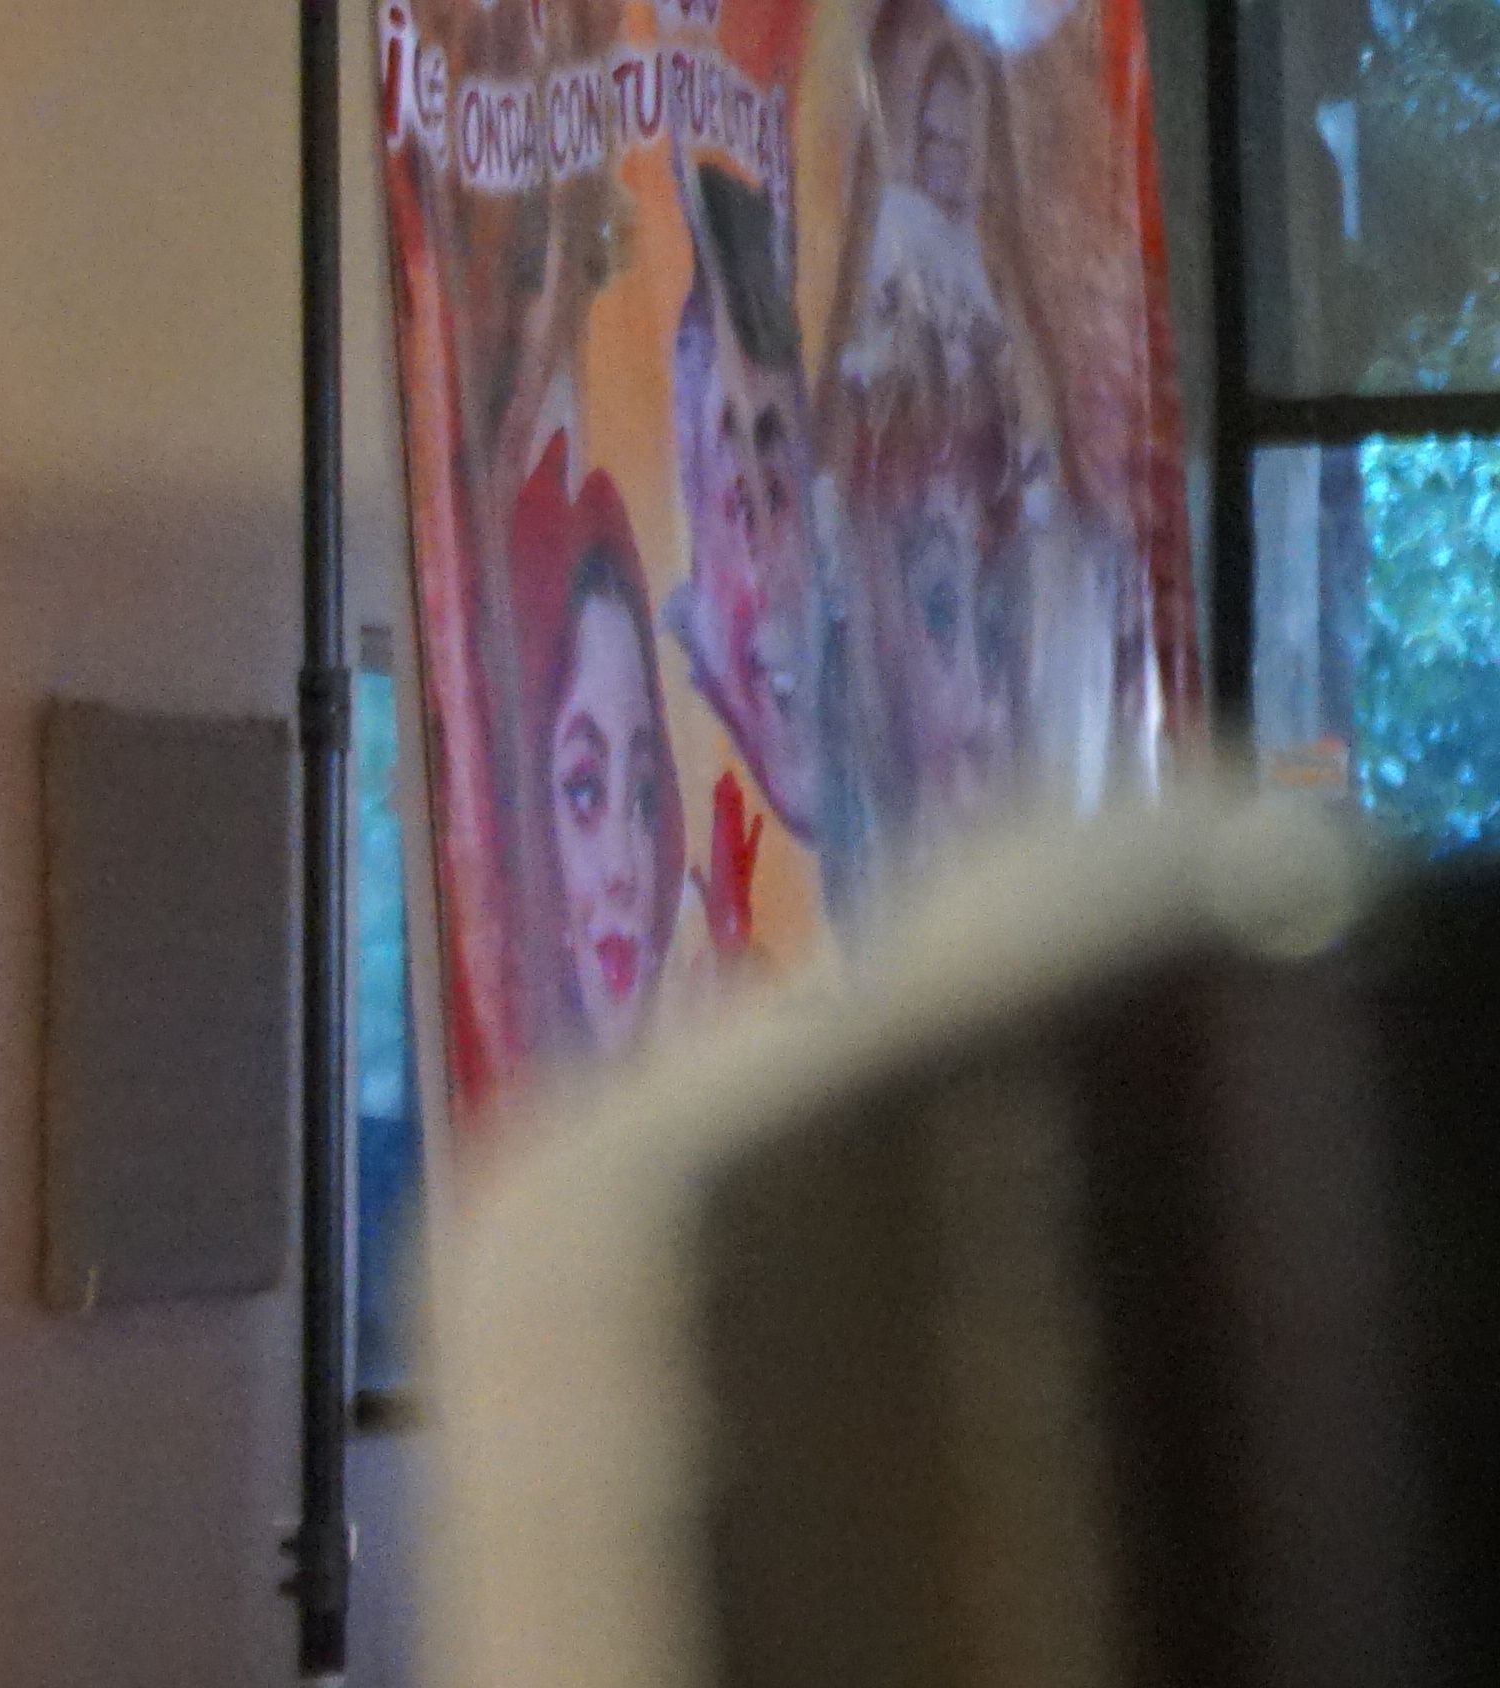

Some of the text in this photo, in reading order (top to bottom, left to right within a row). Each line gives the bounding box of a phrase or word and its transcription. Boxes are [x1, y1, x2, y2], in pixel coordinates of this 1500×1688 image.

[463, 88, 537, 176] ONDA
[549, 72, 604, 164] CON
[612, 52, 664, 140] TU
